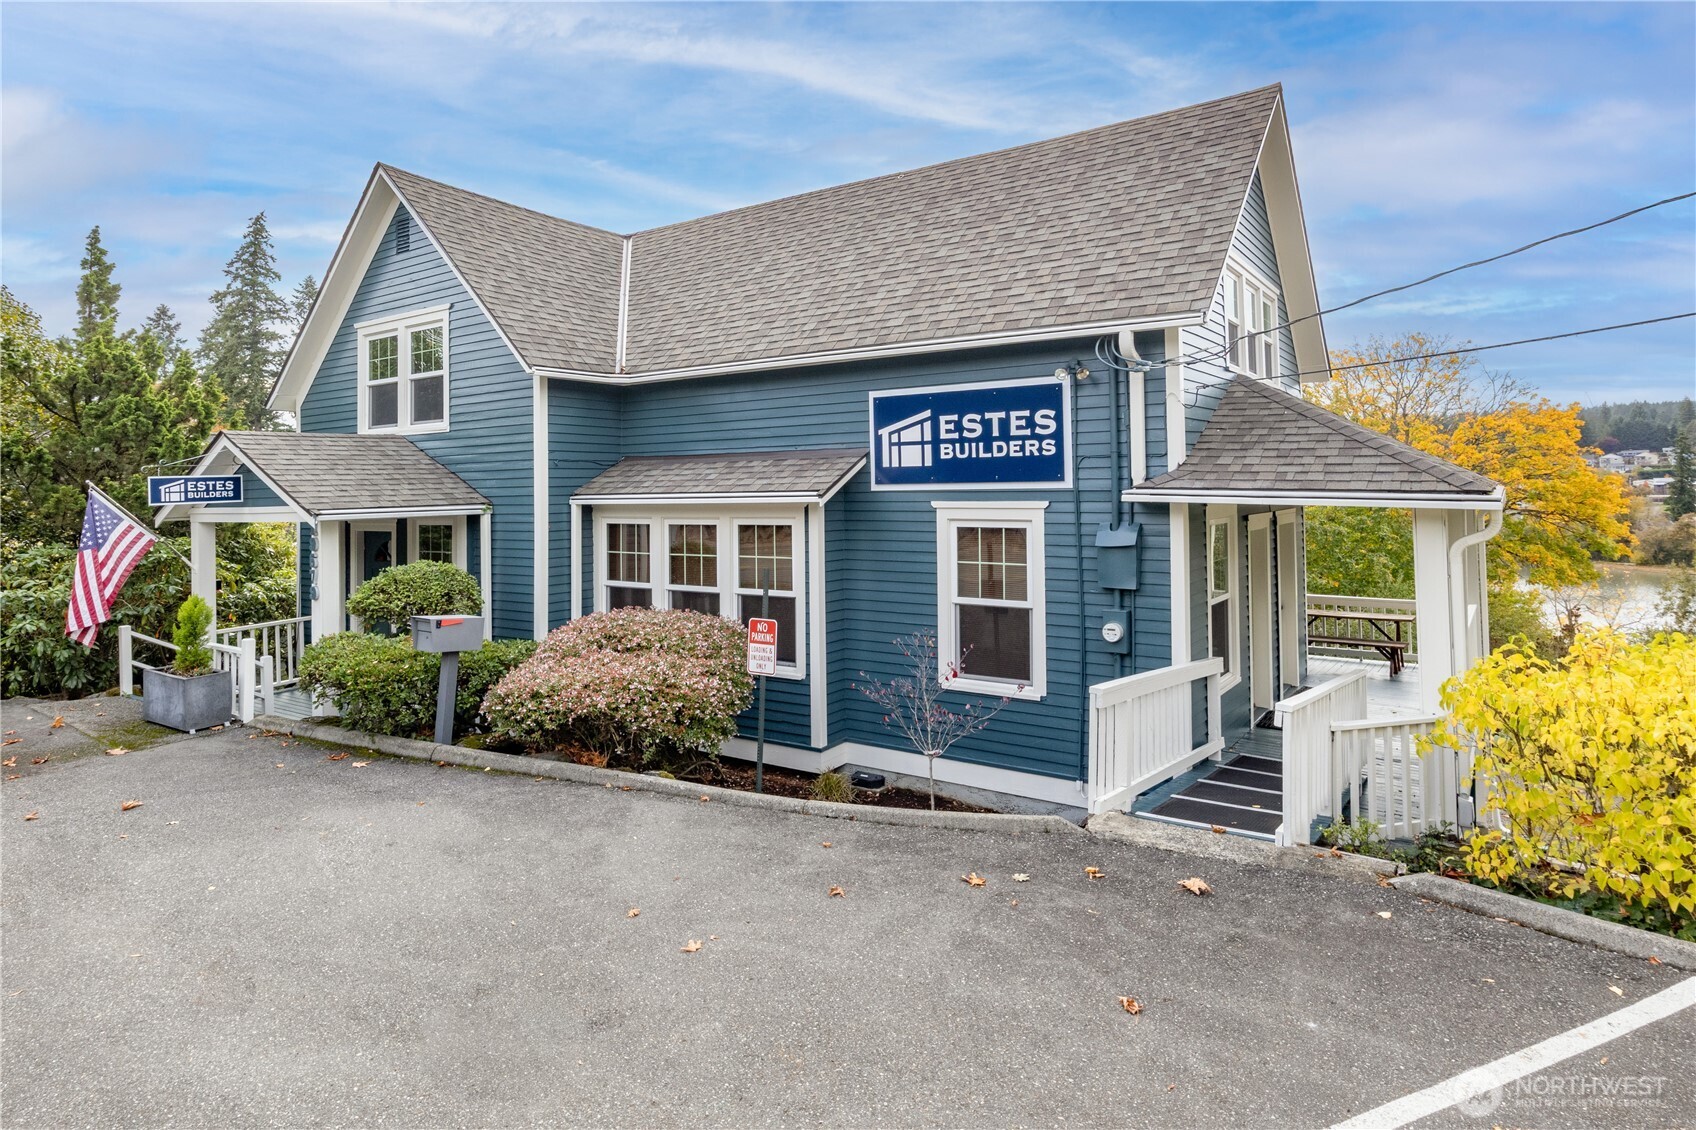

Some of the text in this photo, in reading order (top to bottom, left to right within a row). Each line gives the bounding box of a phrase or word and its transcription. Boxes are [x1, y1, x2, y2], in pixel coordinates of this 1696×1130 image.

[938, 409, 1057, 439] ESTES
[939, 439, 1057, 460] BUILDERS
[187, 480, 234, 491] ESTES
[187, 490, 234, 499] BUILDERS
[757, 622, 768, 632] NO
[751, 632, 774, 643] PARKING
[751, 646, 768, 654] LOADING
[751, 654, 773, 662] UNLOADING
[756, 662, 767, 670] ONLY
